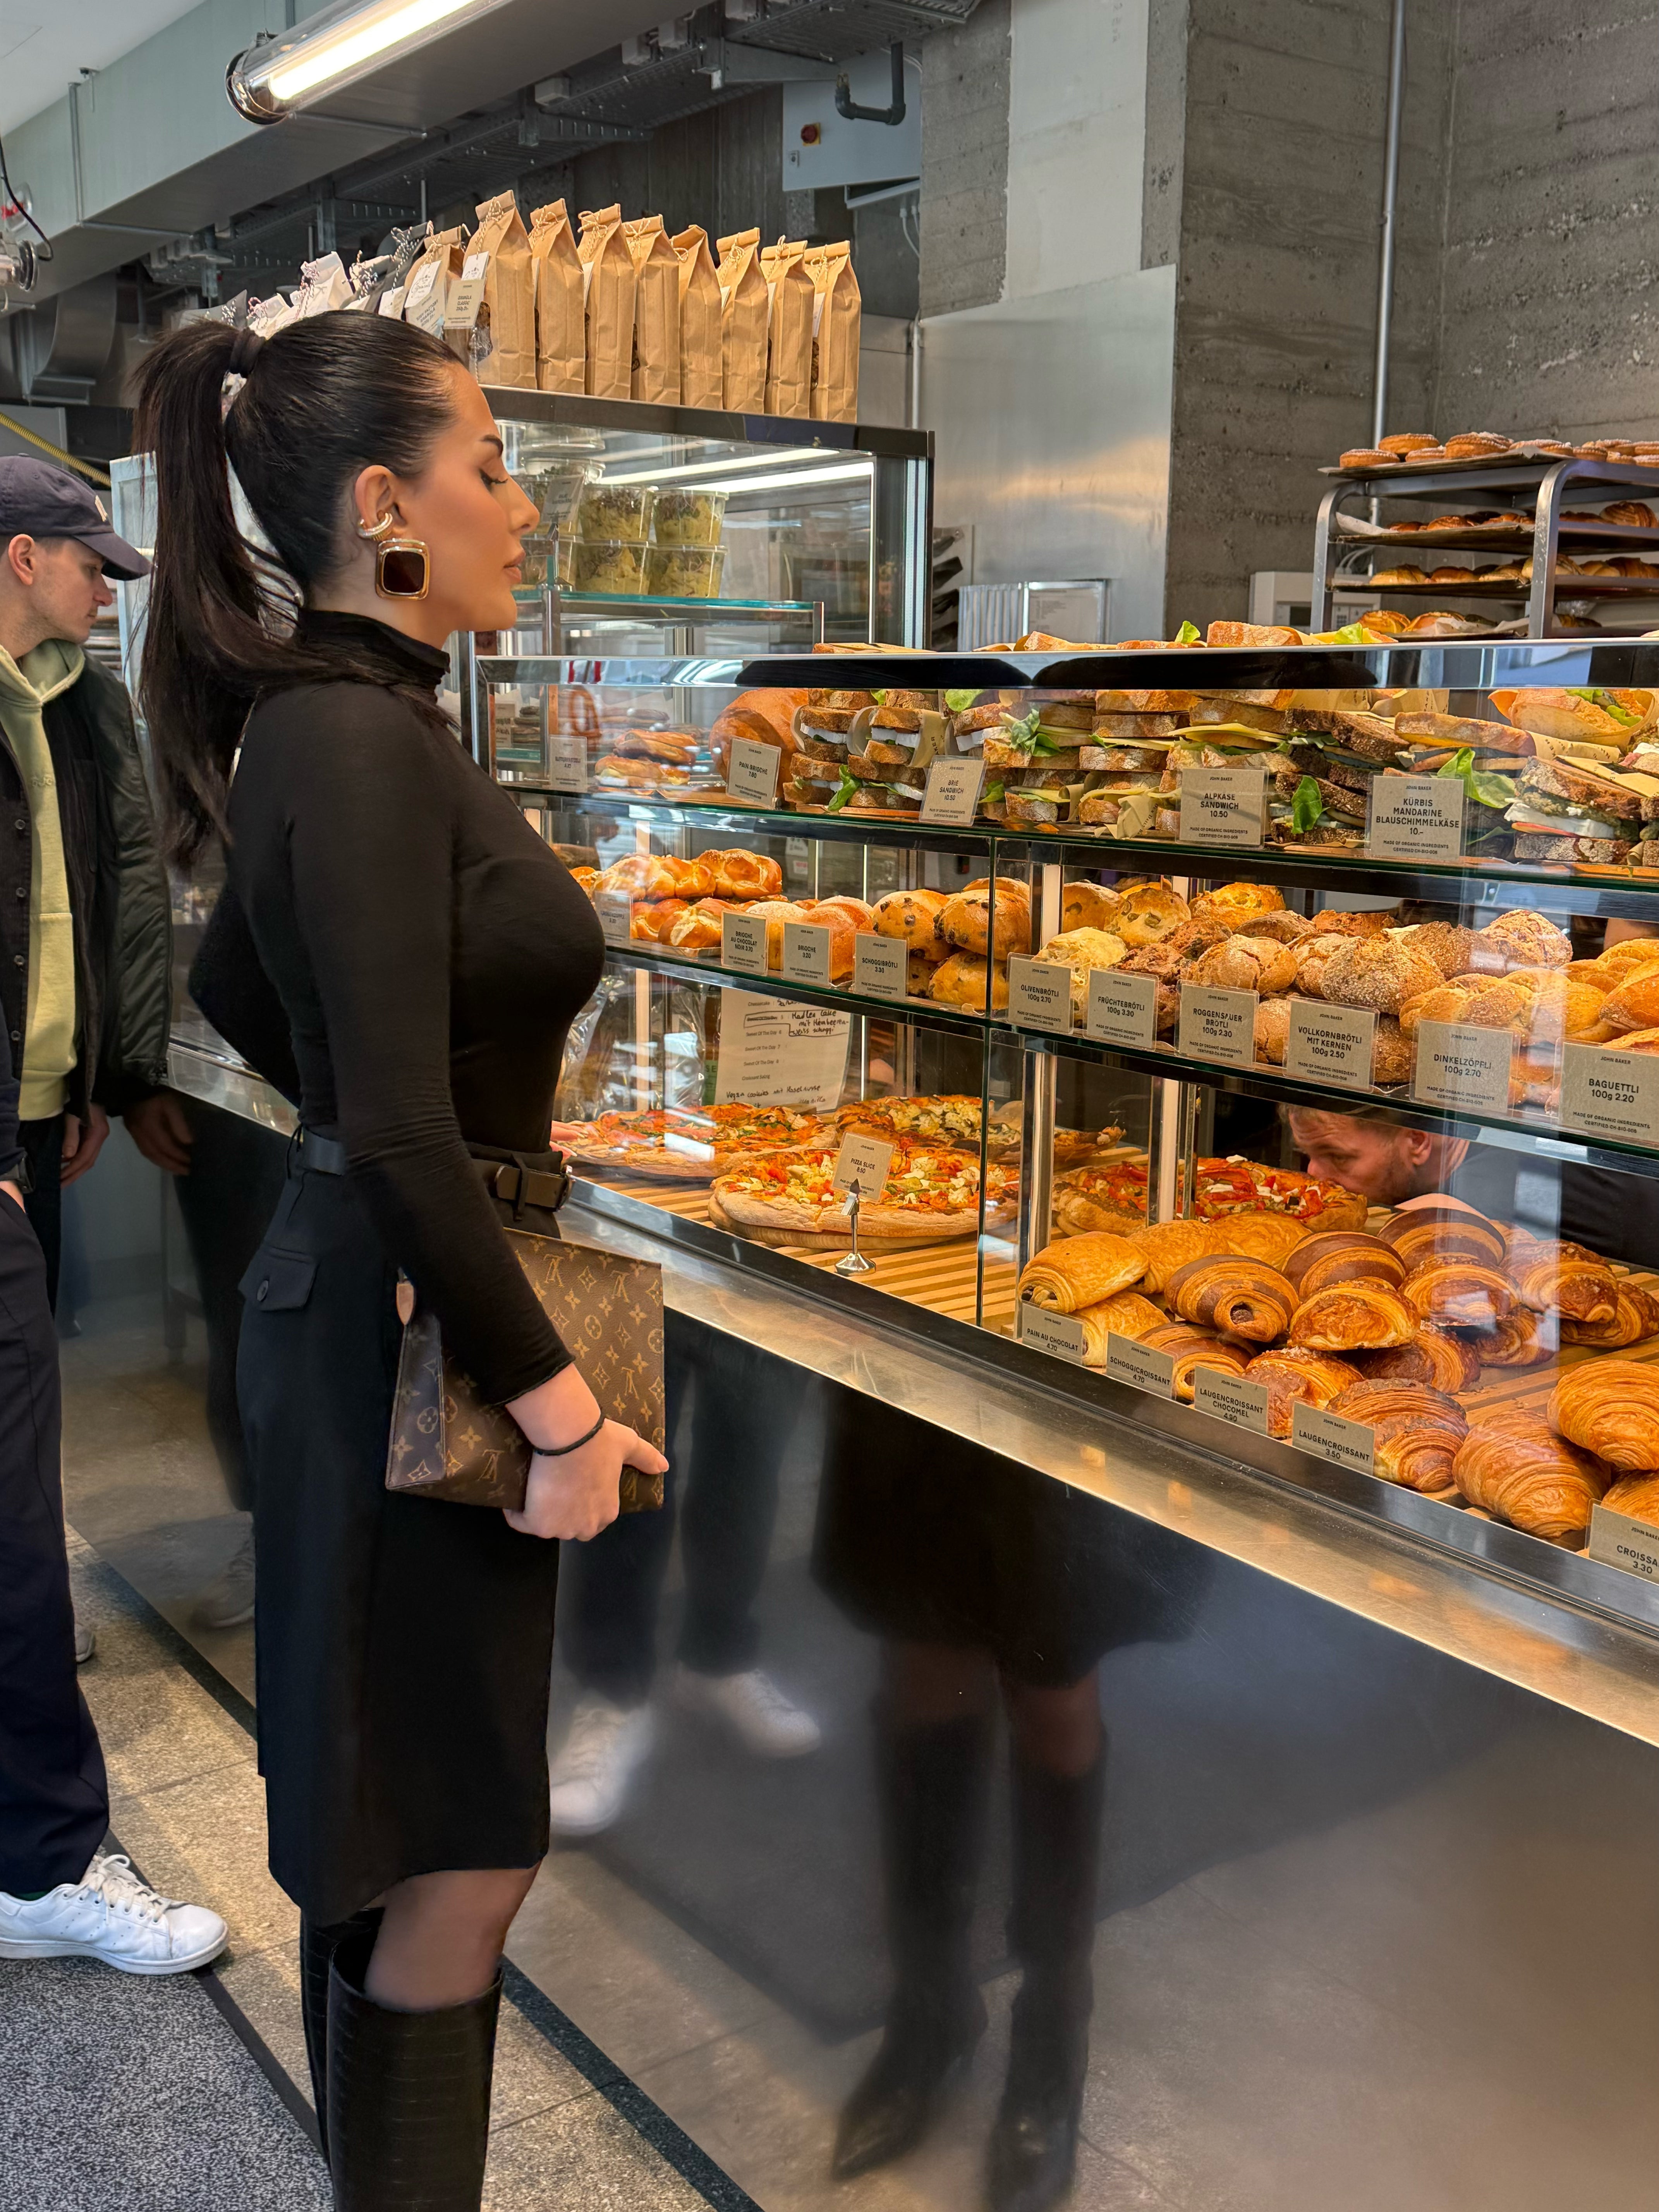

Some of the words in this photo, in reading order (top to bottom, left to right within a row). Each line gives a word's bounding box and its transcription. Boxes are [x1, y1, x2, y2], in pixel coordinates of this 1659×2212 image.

[931, 737, 939, 755] AKER
[750, 764, 768, 775] BRIOCHE
[1200, 801, 1238, 809] SANDWICH
[1403, 797, 1432, 806] KÜRBIS
[1393, 807, 1442, 817] MANDARINE
[1376, 816, 1459, 828] BLAUSCHIMMELKÄSE
[737, 938, 757, 946] CHOCOLAT
[862, 958, 898, 968] SCHOGGIBRÖTLI
[1021, 984, 1059, 997] OLIVENBRÖTLI
[1028, 994, 1039, 1002] 100g
[1098, 996, 1144, 1011] FRÜCHTEBRÖTLI
[1107, 1006, 1120, 1015] 100g
[1194, 1008, 1242, 1022] ROGGENSAUER
[1206, 1018, 1228, 1028] BRÖTLI
[1203, 1027, 1217, 1036] 100g
[1219, 1029, 1232, 1037] 2.30
[1298, 1026, 1362, 1044] VOLLKORNBRÖTLI
[1321, 1040, 1351, 1051] KERNEN
[1312, 1047, 1328, 1056] 100g
[1330, 1050, 1345, 1059] 2.50
[1434, 1054, 1491, 1069] DINKELZÖPFLI
[1332, 1068, 1357, 1077] INGREDIENTS
[1444, 1065, 1463, 1075] 100g
[1465, 1068, 1481, 1077] 2.70
[1589, 1079, 1639, 1093] BAGUETTLI
[1466, 1092, 1494, 1101] INGREDIENTS
[1592, 1089, 1613, 1101] 100g
[1615, 1093, 1634, 1103] 2.20
[1585, 1120, 1608, 1128] CERTIFIED
[1617, 1119, 1650, 1129] INGREDIENTS
[851, 1158, 862, 1166] PIZZA
[863, 1161, 875, 1170] SLICE
[1027, 1328, 1039, 1337] PAIN
[1050, 1336, 1078, 1351] CHOCOLAT
[1047, 1343, 1057, 1351] 4.70
[1110, 1356, 1170, 1385] SCHOGGICROISSANT
[1133, 1374, 1144, 1383] 4.70
[1200, 1388, 1263, 1414] LAUGENCROISSANT
[1213, 1401, 1249, 1418] CHOCOMEL
[1224, 1413, 1237, 1422] 4.90
[1299, 1430, 1369, 1461] LAUGENCROISSANT
[1326, 1449, 1341, 1459] 3.50
[1617, 1545, 1659, 1567] CROISSA
[1633, 1561, 1652, 1574] 3.30
